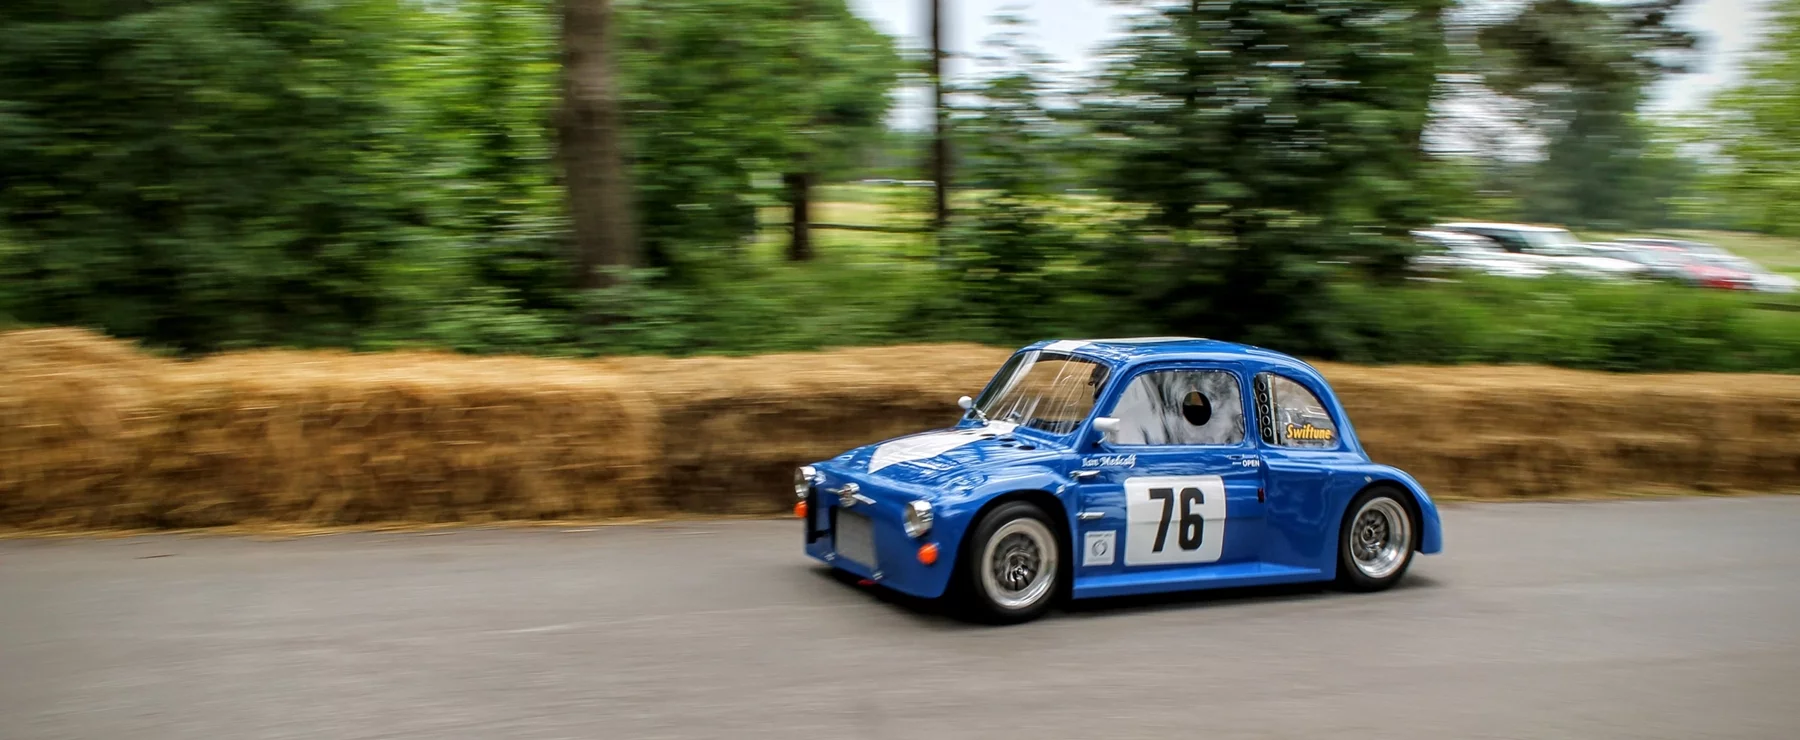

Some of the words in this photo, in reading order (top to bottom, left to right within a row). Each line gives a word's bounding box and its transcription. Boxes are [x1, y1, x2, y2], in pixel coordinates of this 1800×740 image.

[1286, 423, 1332, 440] Swiftune
[1242, 459, 1260, 468] OPEN
[1148, 487, 1205, 554] 76
